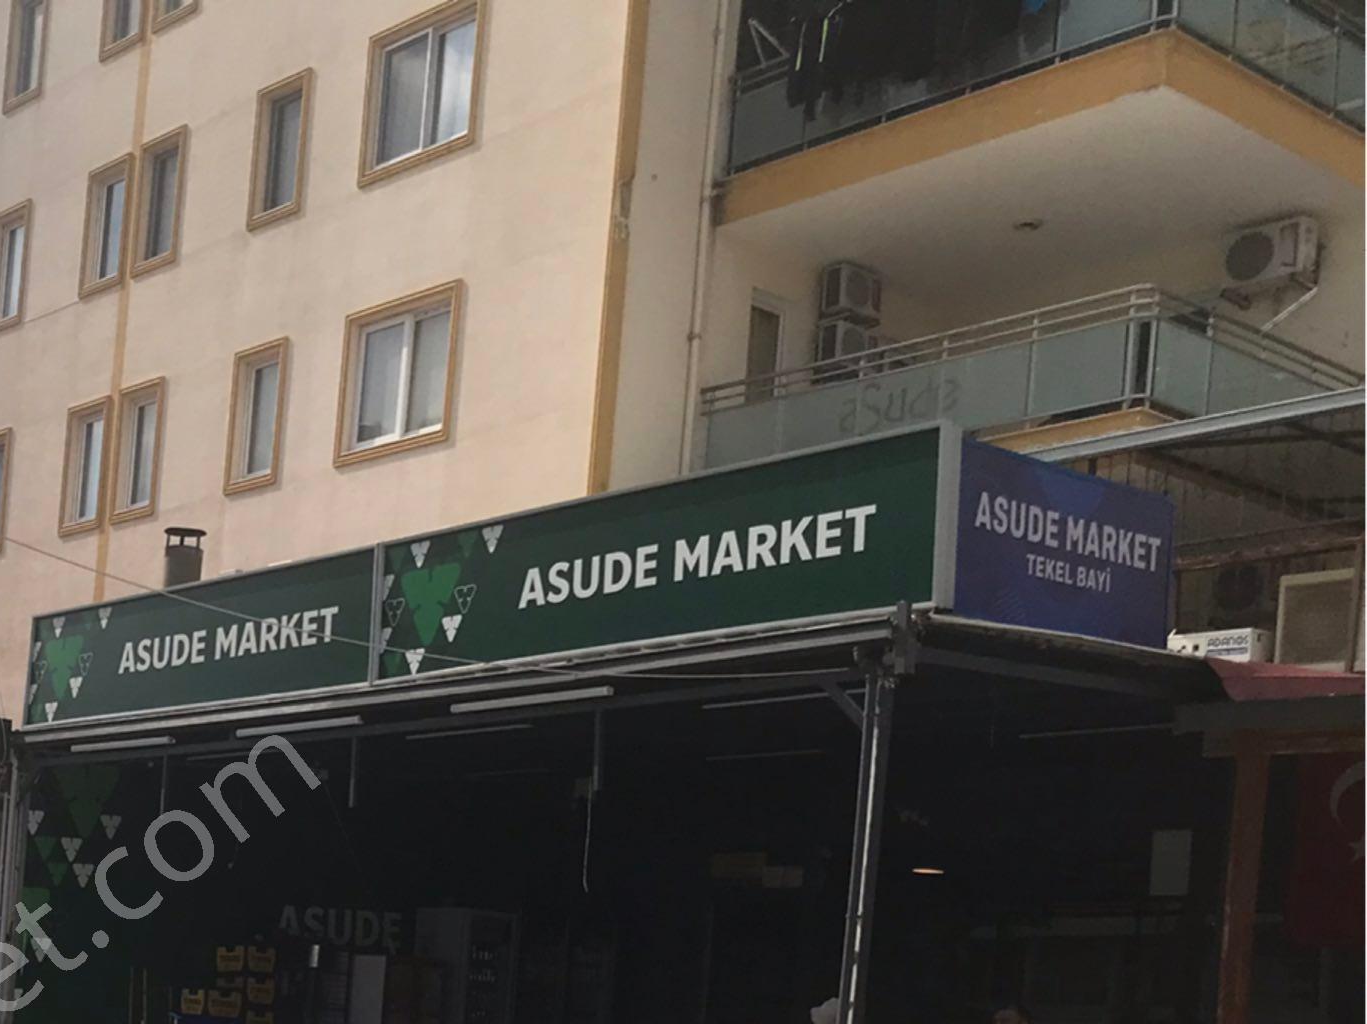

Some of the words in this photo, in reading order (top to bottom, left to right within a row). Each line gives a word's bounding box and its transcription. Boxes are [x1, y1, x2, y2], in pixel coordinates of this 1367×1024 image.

[518, 544, 659, 609] ASUDE
[673, 504, 877, 582] MARKET
[974, 491, 1059, 548] ASUDE
[1066, 515, 1162, 572] MARKET
[1026, 553, 1073, 586] TEKEL
[1076, 566, 1112, 593] BAYİ
[118, 630, 207, 674] ASUDE
[214, 606, 339, 660] MARKET
[279, 904, 402, 947] ASUDE
